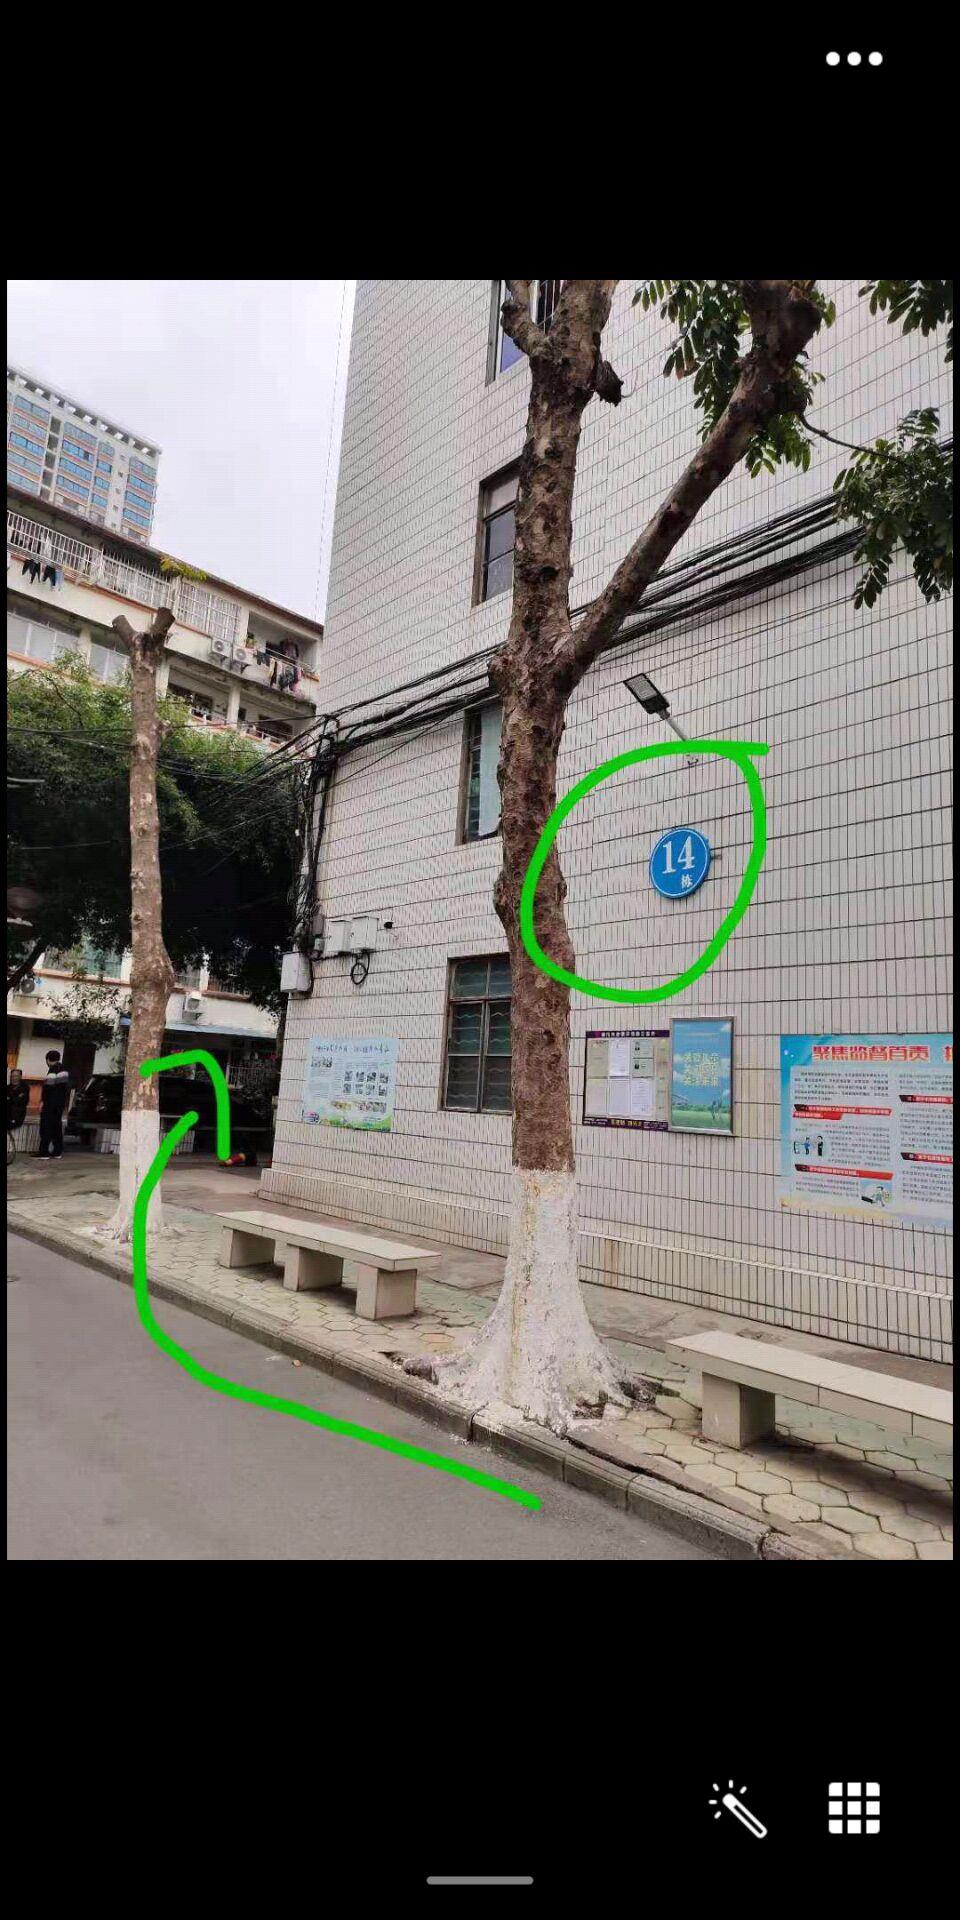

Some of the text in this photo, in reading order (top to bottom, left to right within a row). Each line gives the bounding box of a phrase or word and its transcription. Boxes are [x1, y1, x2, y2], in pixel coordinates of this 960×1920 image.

[662, 836, 695, 874] 14
[681, 874, 693, 889] 栋
[812, 1045, 930, 1062] 聚焦监督首责
